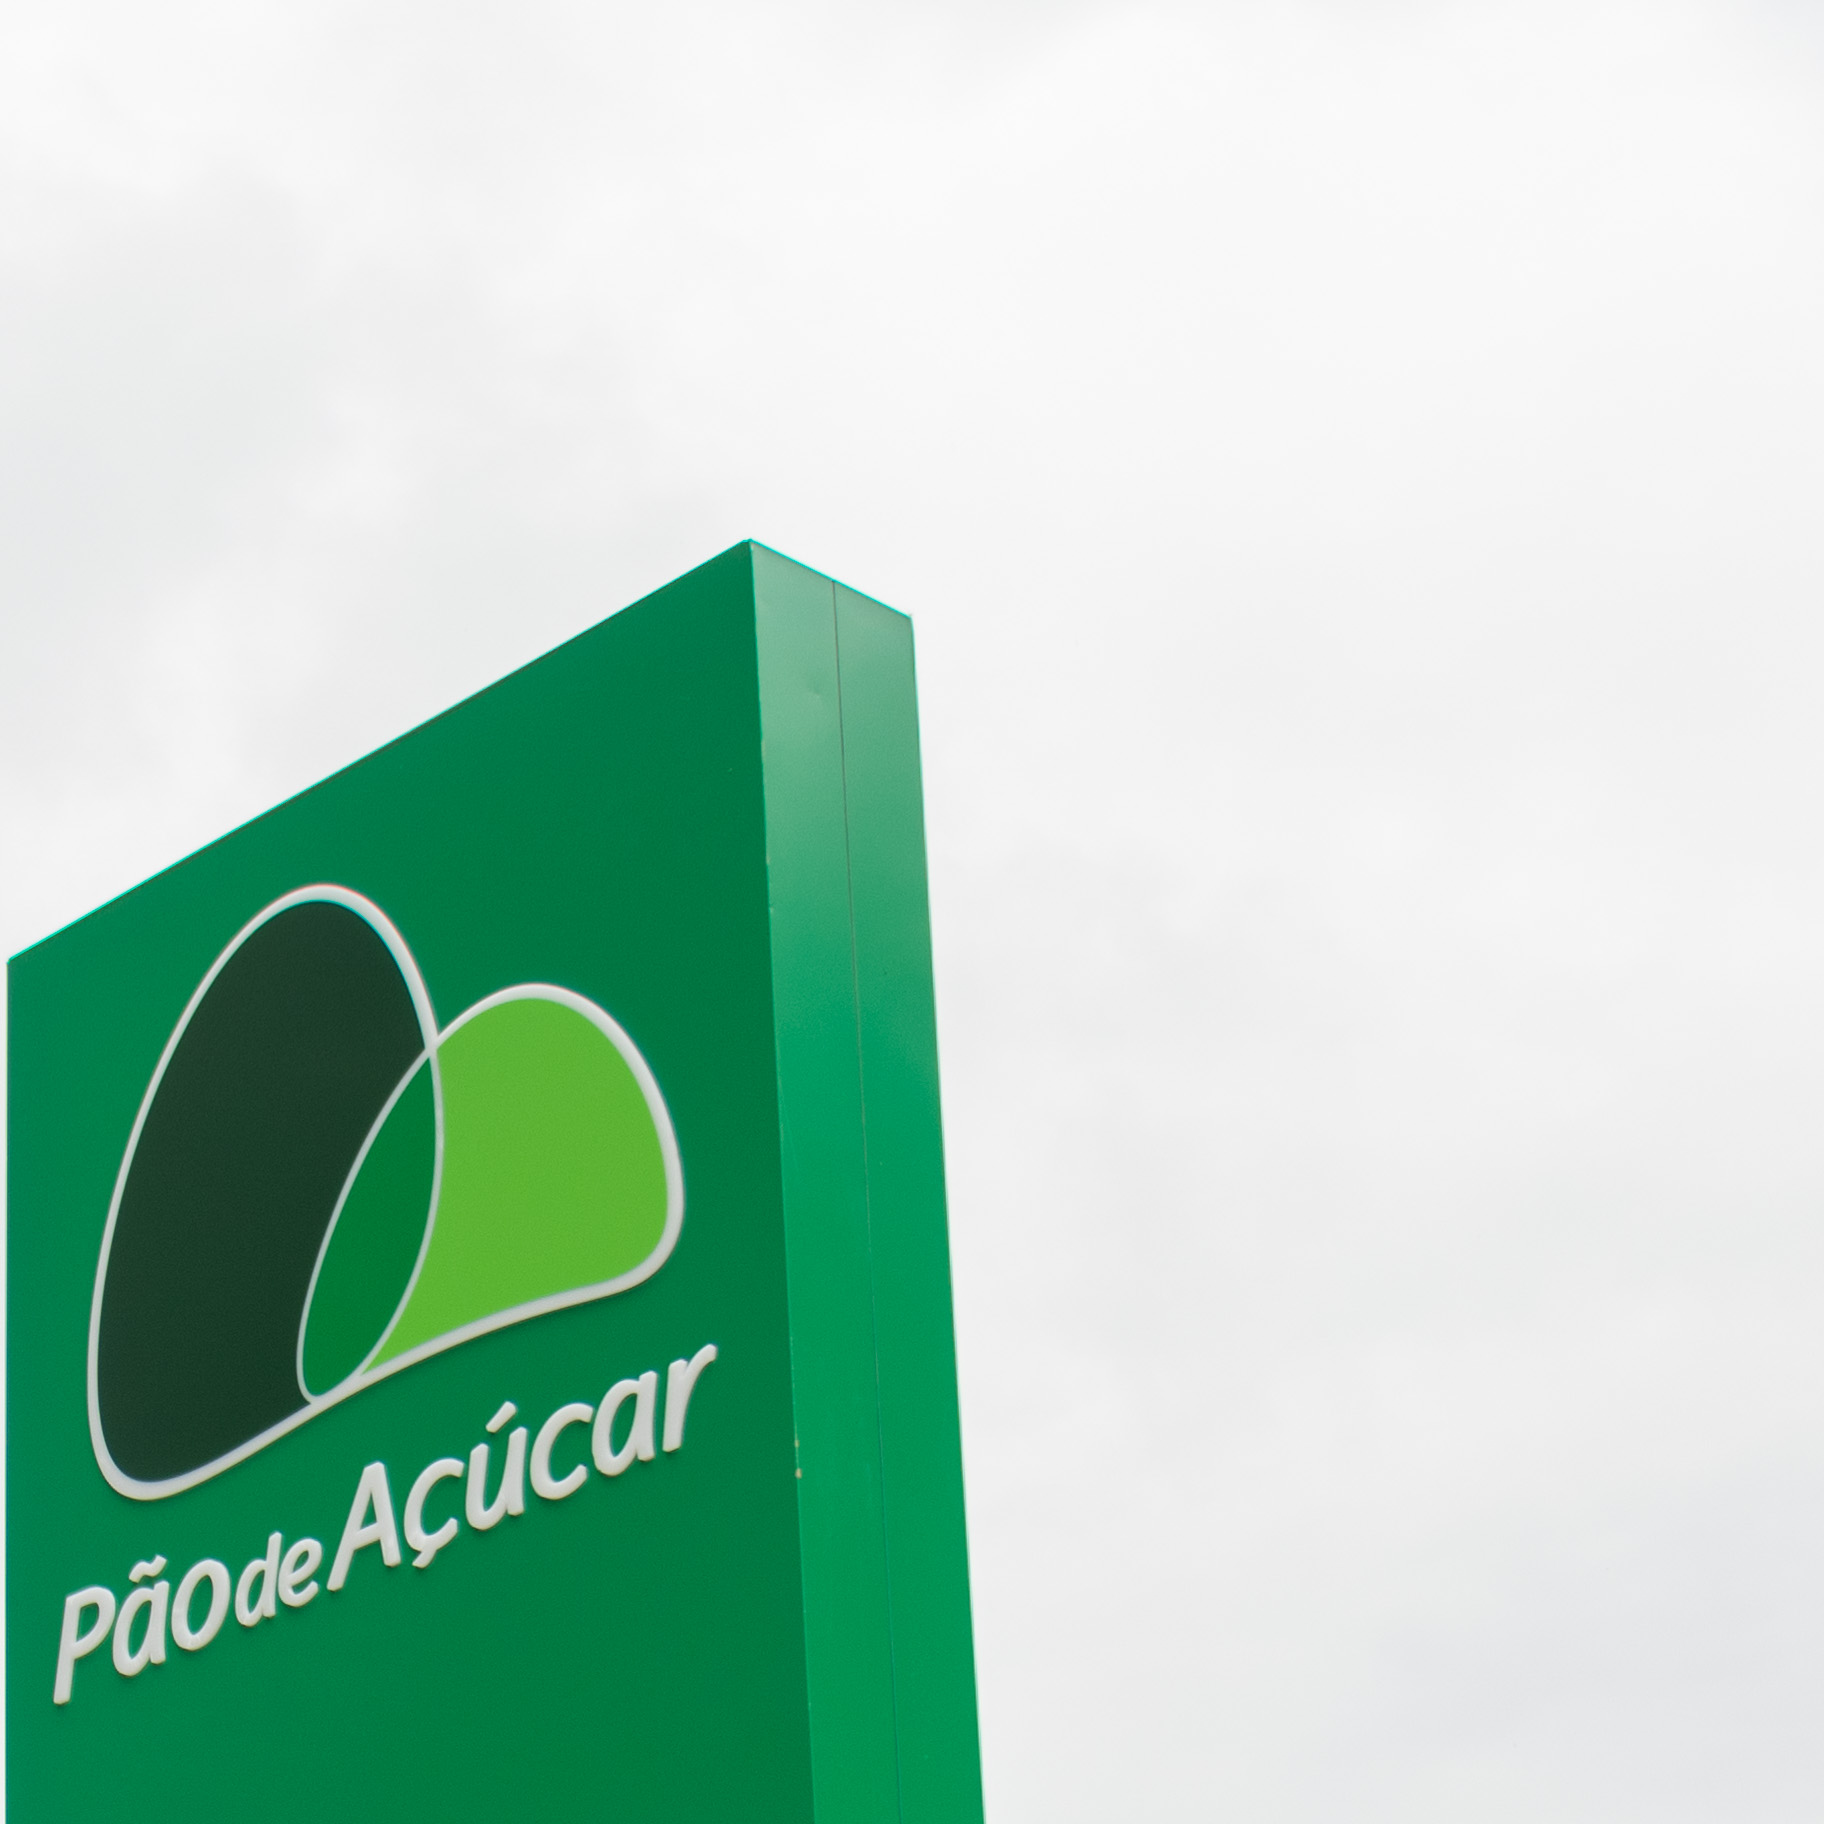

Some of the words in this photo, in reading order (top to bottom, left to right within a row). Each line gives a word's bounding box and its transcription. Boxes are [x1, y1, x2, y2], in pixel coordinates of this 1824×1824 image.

[52, 1555, 231, 1705] Pão
[234, 1532, 323, 1628] de
[326, 1343, 718, 1592] Açúcar
